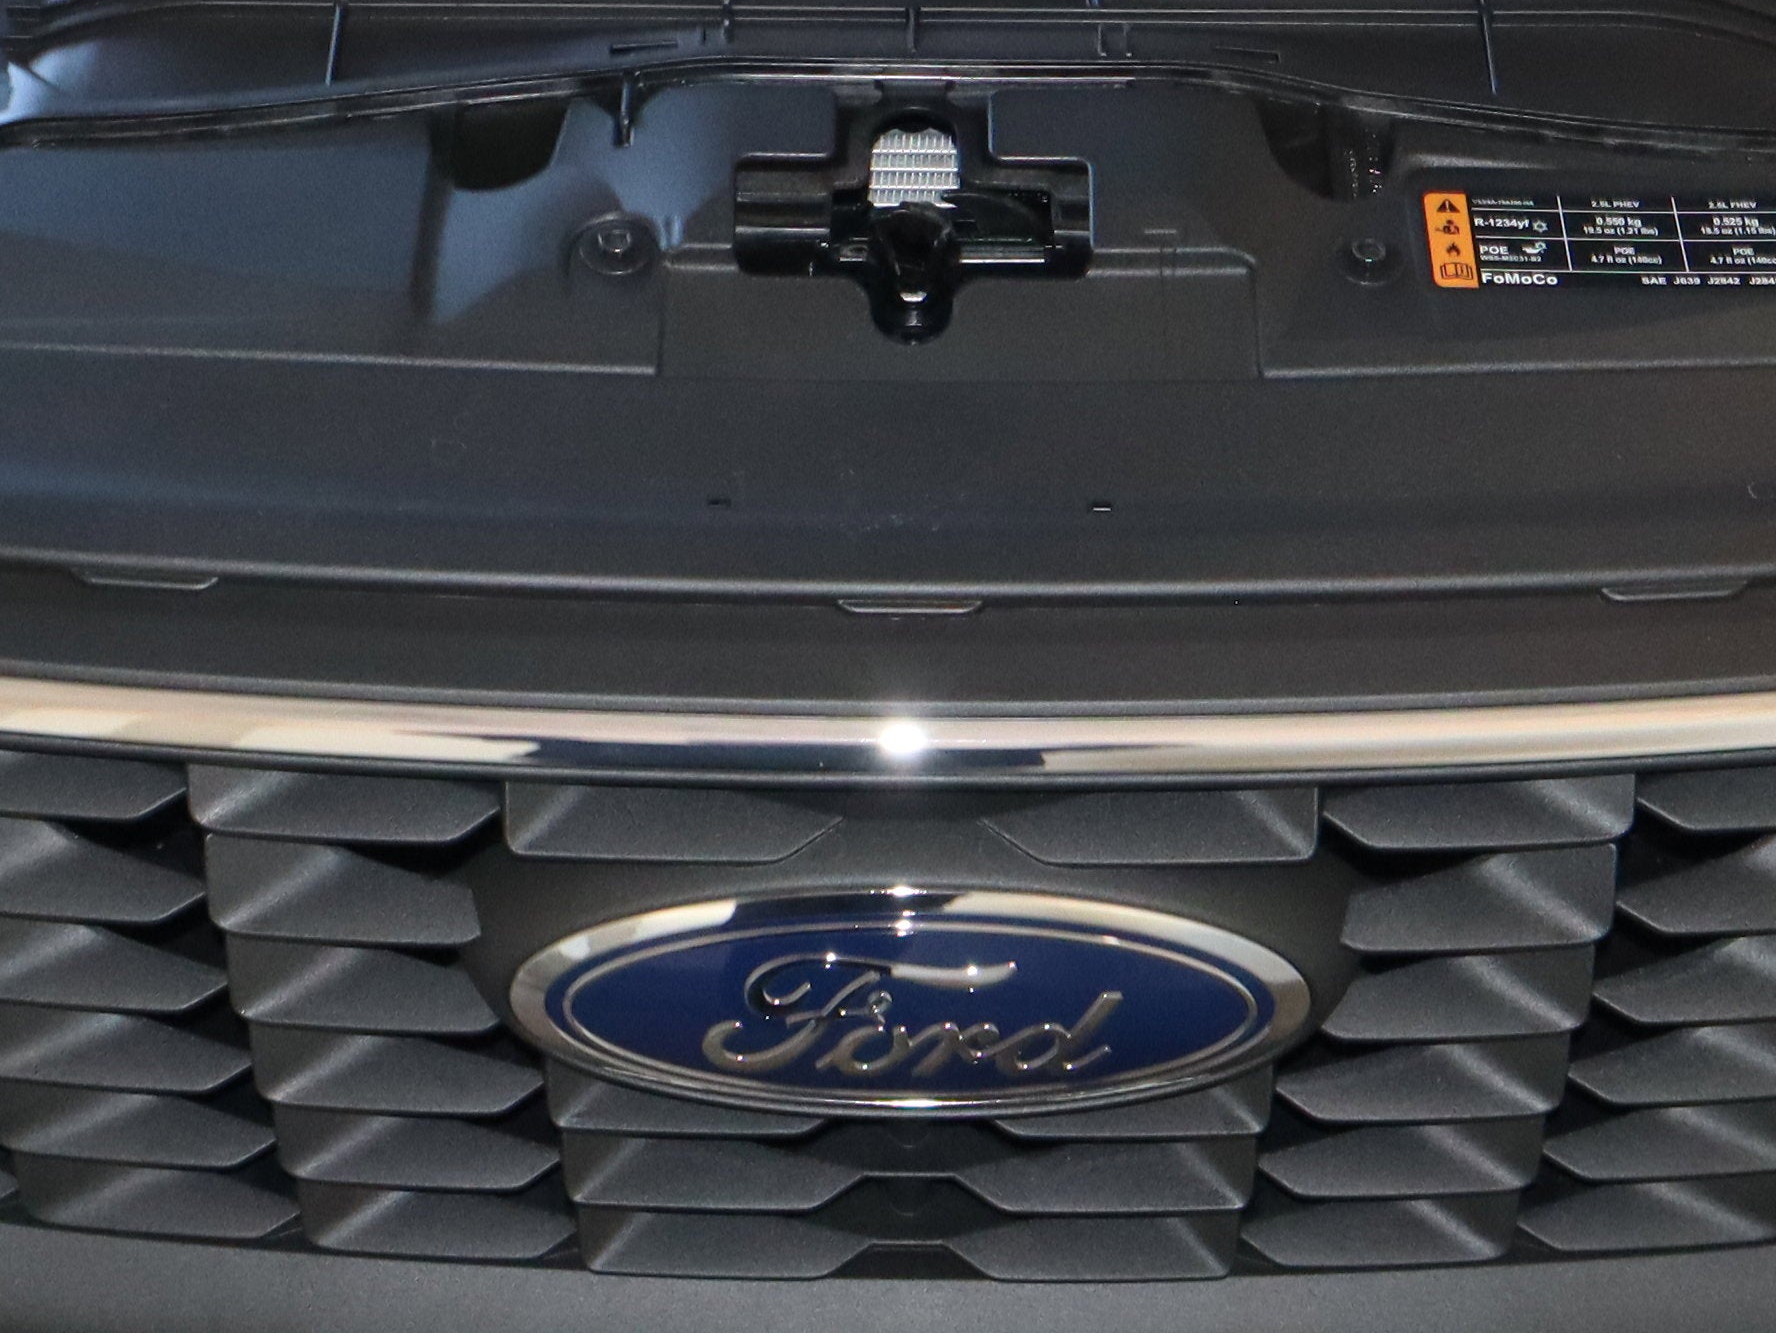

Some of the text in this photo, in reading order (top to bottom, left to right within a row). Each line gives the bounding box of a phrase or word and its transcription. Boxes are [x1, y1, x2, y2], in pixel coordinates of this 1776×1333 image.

[1474, 217, 1530, 230] R-1234yf
[1627, 217, 1642, 228] kg
[1744, 216, 1759, 228] kg
[1479, 244, 1509, 255] POE
[1614, 245, 1635, 255] POE
[1481, 272, 1558, 285] FoMoCo
[1641, 276, 1667, 285] SAE
[1673, 277, 1701, 285] J639
[703, 953, 1124, 1078] Ford
